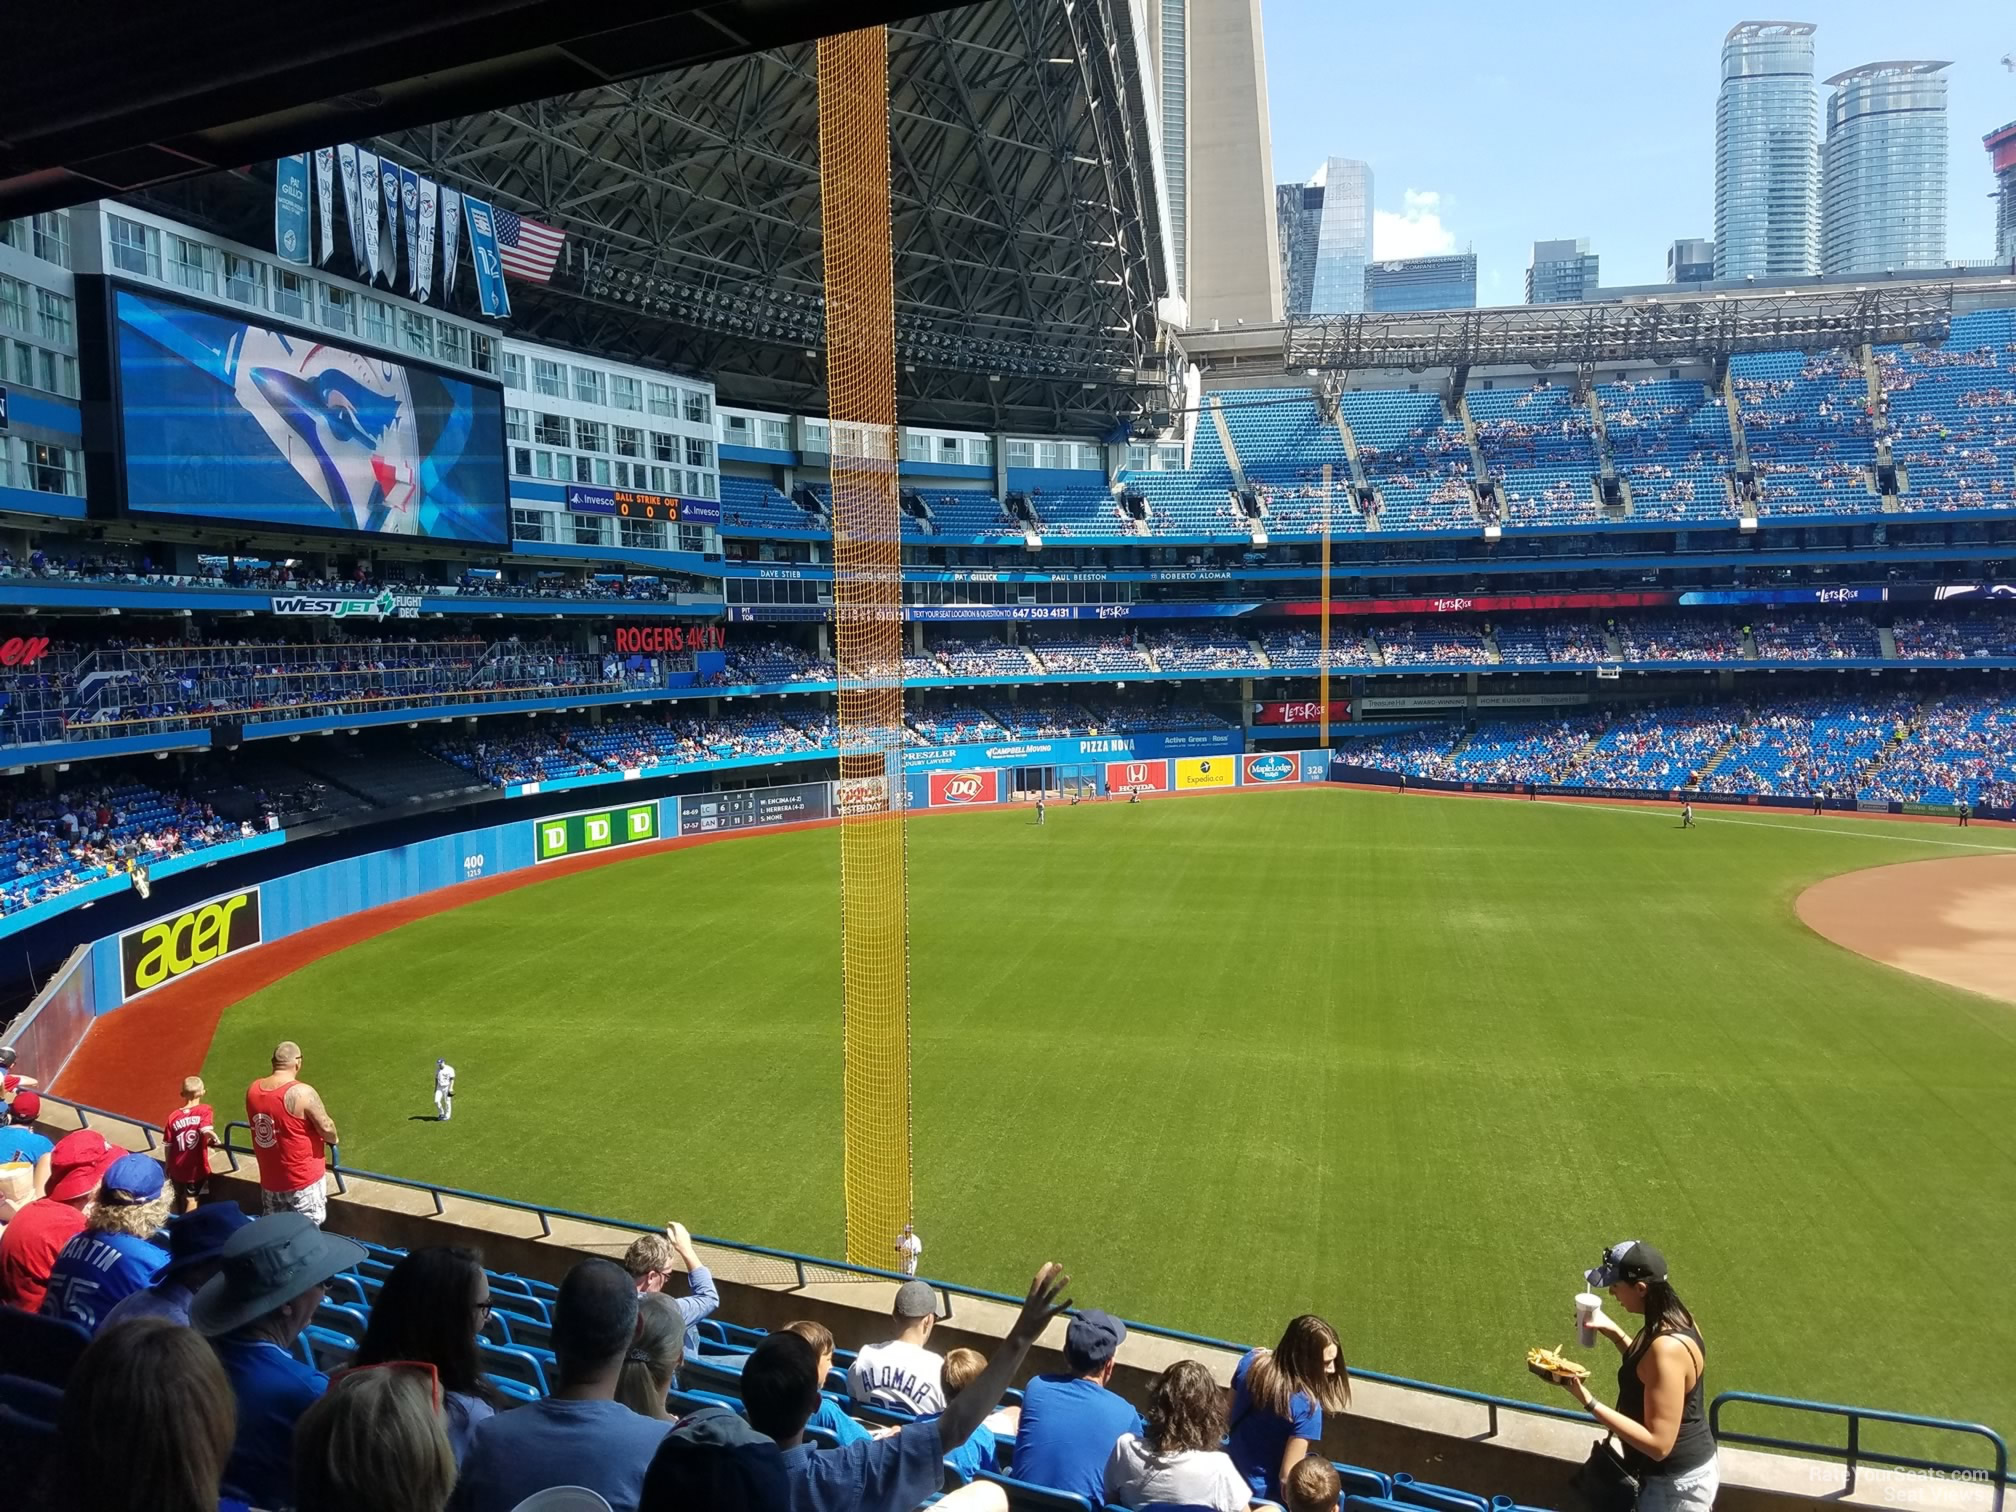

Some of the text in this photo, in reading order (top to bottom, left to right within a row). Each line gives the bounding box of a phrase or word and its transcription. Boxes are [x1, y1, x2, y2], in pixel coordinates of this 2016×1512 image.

[584, 494, 614, 506] Invesco
[615, 492, 678, 507] BALL STRIKE OUT
[621, 503, 677, 520] 0 0 0
[694, 506, 720, 517] Invesco
[760, 569, 779, 578] DAVE
[275, 599, 375, 616] WESTJET
[397, 596, 423, 607] FLIGHT
[400, 608, 420, 618] DECK
[742, 614, 754, 622] TOR
[913, 610, 925, 618] TEXT
[925, 610, 939, 618] YOUR
[939, 610, 951, 618] SEAT
[951, 610, 976, 618] LOCATION
[980, 610, 1004, 619] QUESTION
[1004, 610, 1011, 618] TO
[1012, 608, 1030, 618] 647
[1031, 608, 1049, 618] 503
[1050, 608, 1069, 618] 4131
[616, 627, 726, 652] ROGERS 4K TV
[1080, 738, 1135, 754] PIZZA NOVA
[1164, 736, 1186, 744] Active
[903, 749, 957, 760] PRESZLER
[993, 744, 1052, 755] CAMPBELL MOVING
[926, 757, 953, 765] LAWYERS
[1306, 765, 1323, 775] 328
[1187, 774, 1224, 785] Expedia.ca
[951, 780, 978, 797] DQ
[720, 804, 726, 812] 6
[734, 802, 740, 810] 9
[747, 801, 753, 809] 3
[836, 802, 882, 816] YESTERDAY
[629, 812, 650, 833] TD
[720, 818, 726, 826] 7
[748, 815, 753, 823] 3
[586, 819, 609, 841] TD
[544, 826, 565, 849] TD
[463, 854, 484, 869] 400
[135, 894, 248, 989] acer
[176, 1129, 200, 1151] 19
[63, 1237, 123, 1273] ARTIN
[861, 1365, 931, 1404] ALOMAR
